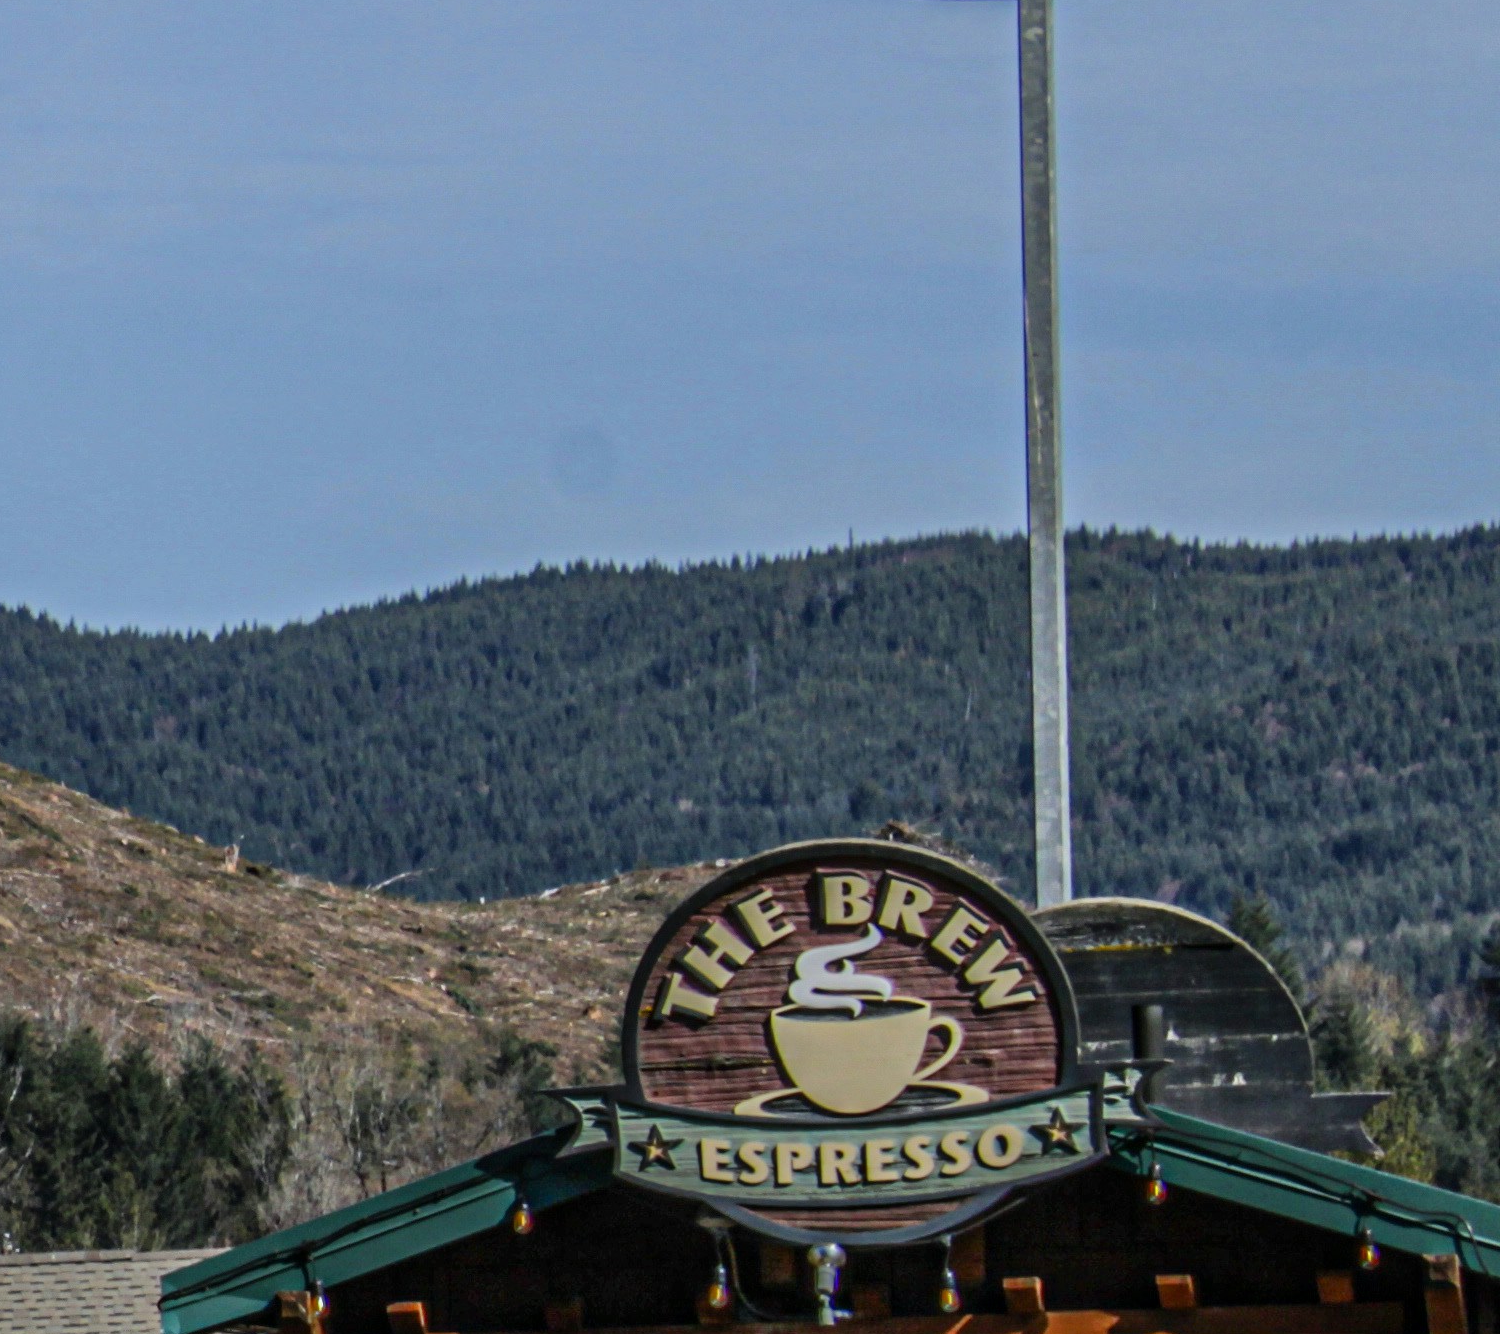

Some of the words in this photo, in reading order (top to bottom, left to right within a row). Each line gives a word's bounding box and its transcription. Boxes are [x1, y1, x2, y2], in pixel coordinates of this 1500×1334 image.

[660, 886, 797, 1020] THE
[820, 873, 1041, 1012] BREW
[700, 1124, 1024, 1186] ESPRESSO
